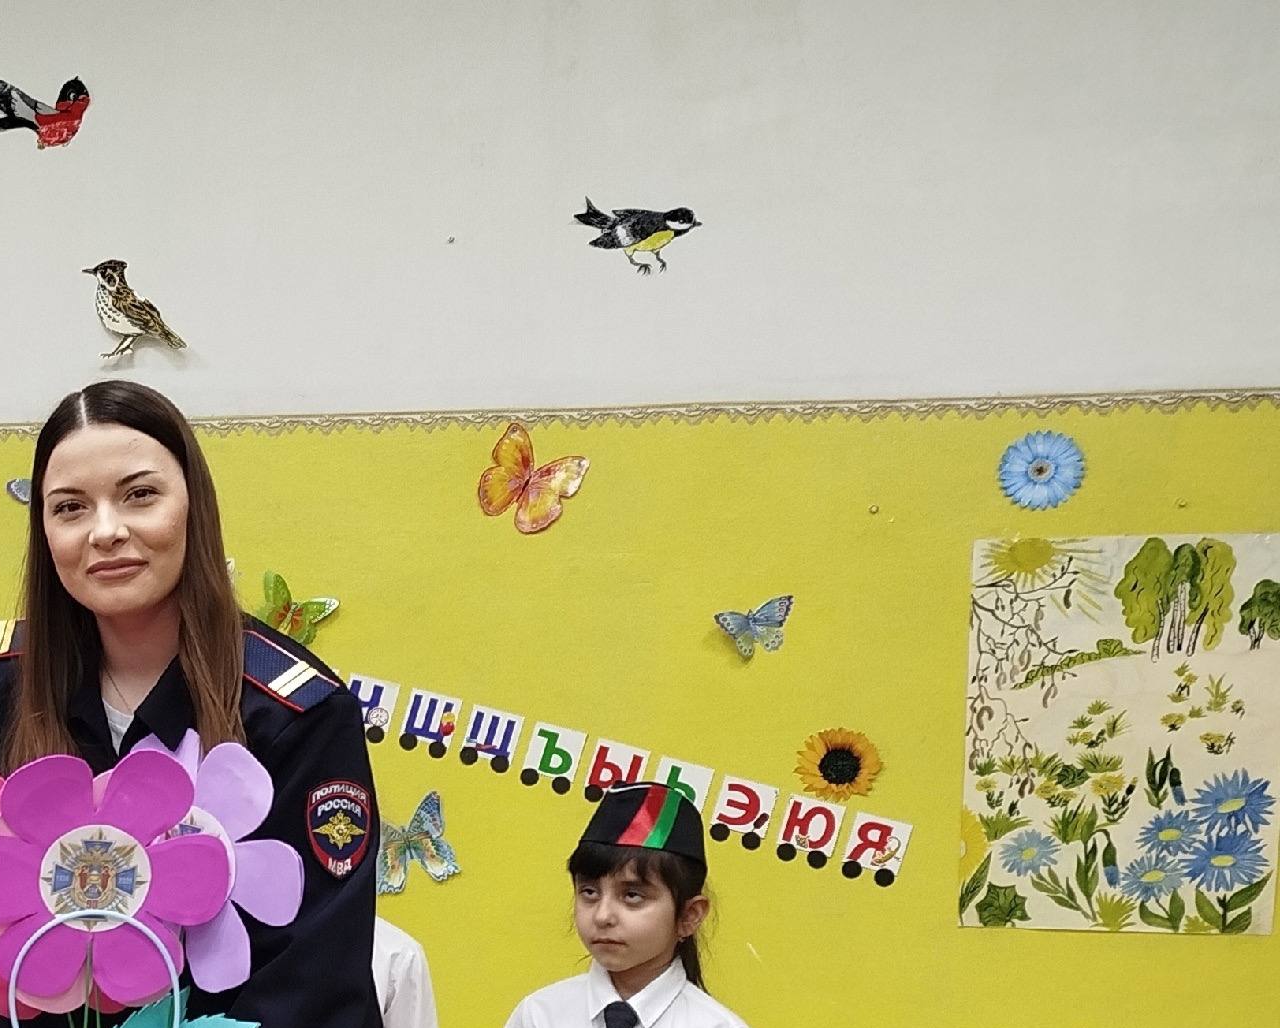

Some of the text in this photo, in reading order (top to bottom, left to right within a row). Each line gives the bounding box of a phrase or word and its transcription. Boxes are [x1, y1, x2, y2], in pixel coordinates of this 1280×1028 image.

[311, 783, 368, 804] ПОЛИЦИЯ
[317, 798, 362, 817] РОССИЯ
[327, 857, 353, 876] МВД
